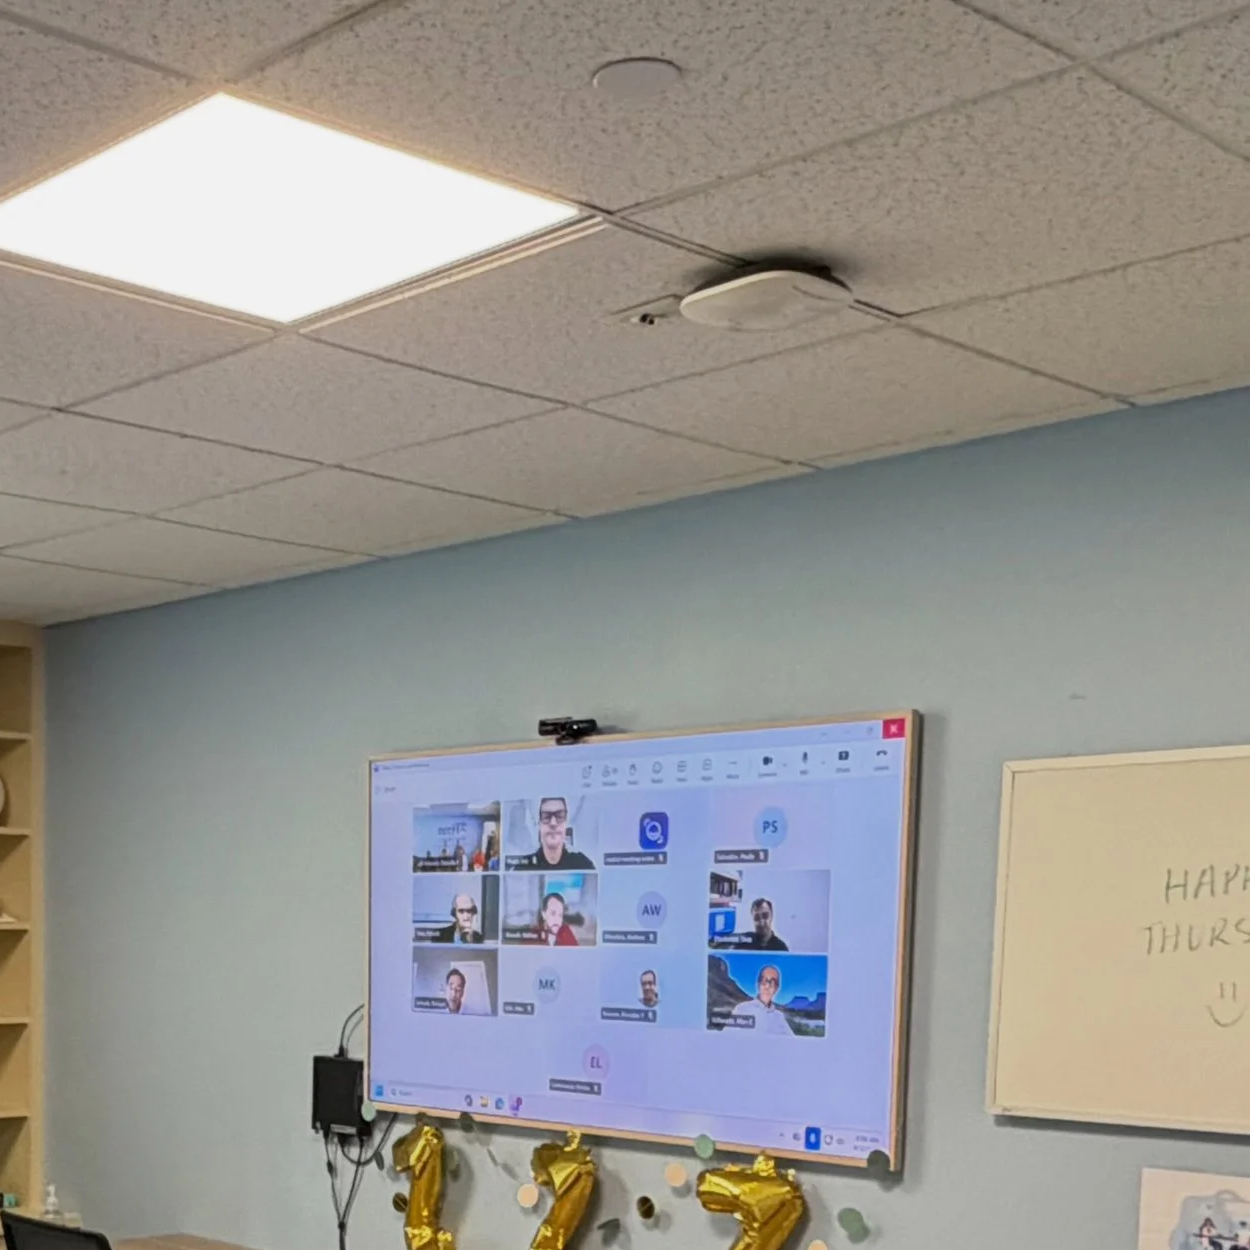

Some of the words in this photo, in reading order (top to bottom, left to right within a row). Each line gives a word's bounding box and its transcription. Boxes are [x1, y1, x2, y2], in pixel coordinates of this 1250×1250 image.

[762, 820, 778, 834] PS
[641, 903, 662, 917] AW
[538, 978, 556, 991] MK
[590, 1055, 602, 1068] EL
